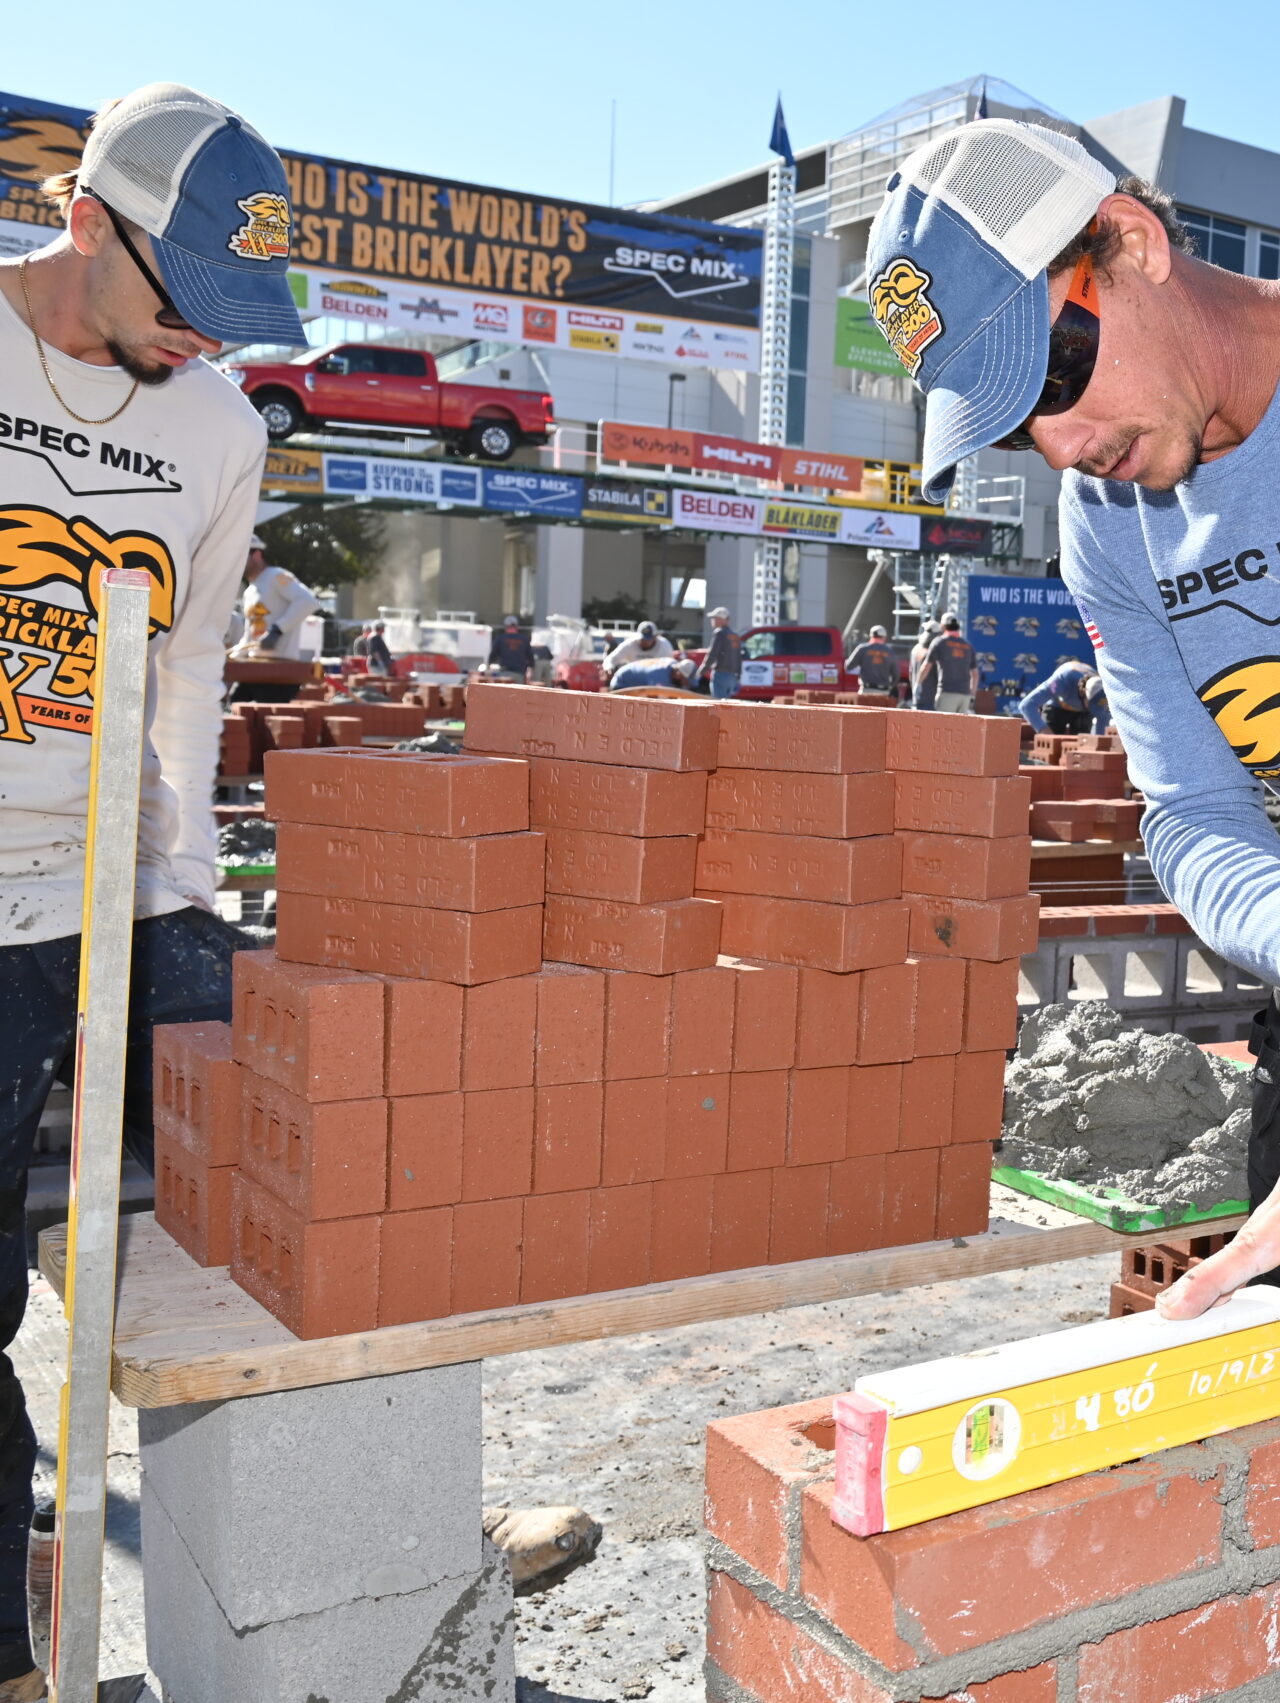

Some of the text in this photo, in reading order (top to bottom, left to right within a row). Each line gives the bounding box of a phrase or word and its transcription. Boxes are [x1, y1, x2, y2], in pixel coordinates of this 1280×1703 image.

[288, 157, 588, 253] HO IS THE WORLD'S
[288, 212, 573, 298] EST BRICKLAYER?
[615, 246, 737, 280] SPEC MIX
[321, 295, 389, 319] BELDEN
[569, 312, 623, 330] HILTI
[902, 304, 931, 340] 500
[0, 412, 91, 458] SPEC
[632, 435, 690, 457] Kubota
[703, 445, 772, 470] HILTI
[372, 464, 415, 477] KEEPING
[794, 459, 850, 482] STIHL
[373, 475, 435, 495] STRONG
[493, 474, 570, 493] SPEC MIX
[588, 488, 642, 506] STABILA
[680, 493, 756, 520] BELDEN
[766, 507, 840, 529] BLÅKLÄDER
[1157, 548, 1269, 610] SPEC
[981, 587, 1076, 606] WHO IS THE WOR
[0, 594, 91, 631] PEC MIX
[30, 703, 91, 725] YEARS OF
